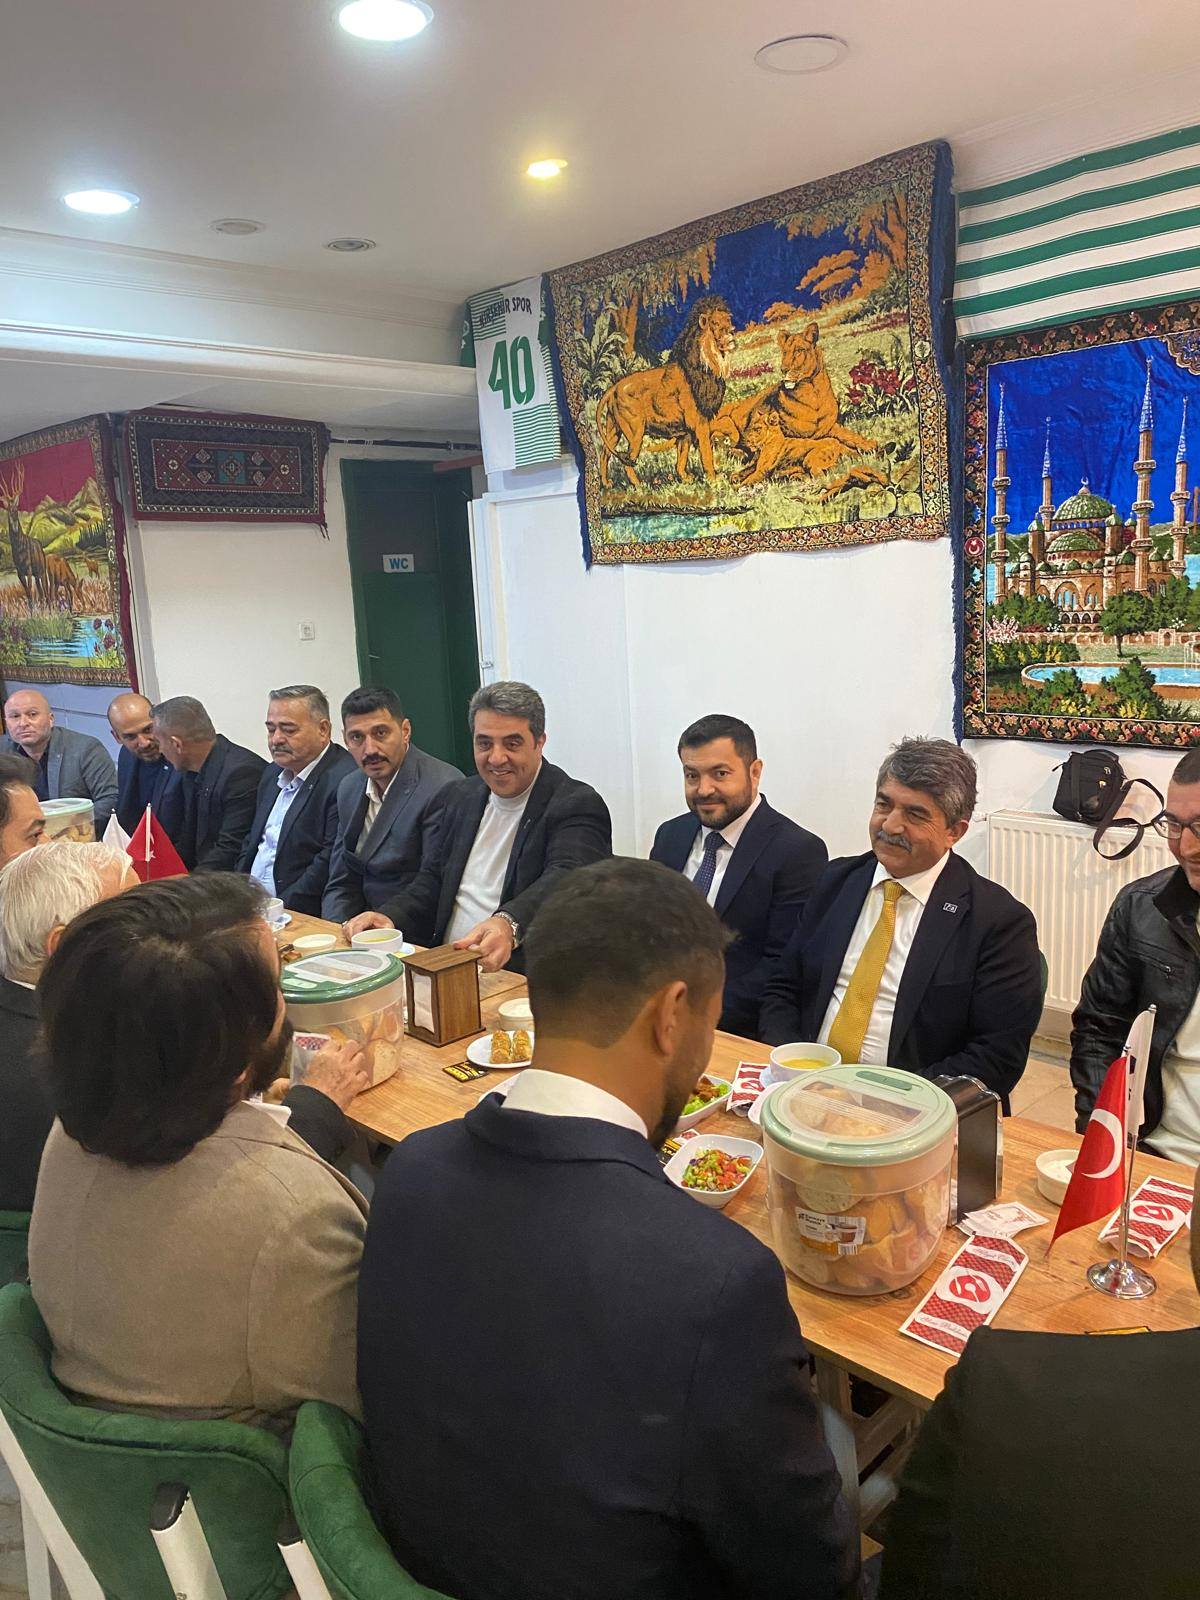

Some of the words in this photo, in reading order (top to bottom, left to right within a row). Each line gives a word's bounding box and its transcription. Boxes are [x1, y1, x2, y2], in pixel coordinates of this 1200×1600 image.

[512, 297, 532, 315] SPOR
[488, 336, 535, 410] 40
[389, 558, 409, 570] WC
